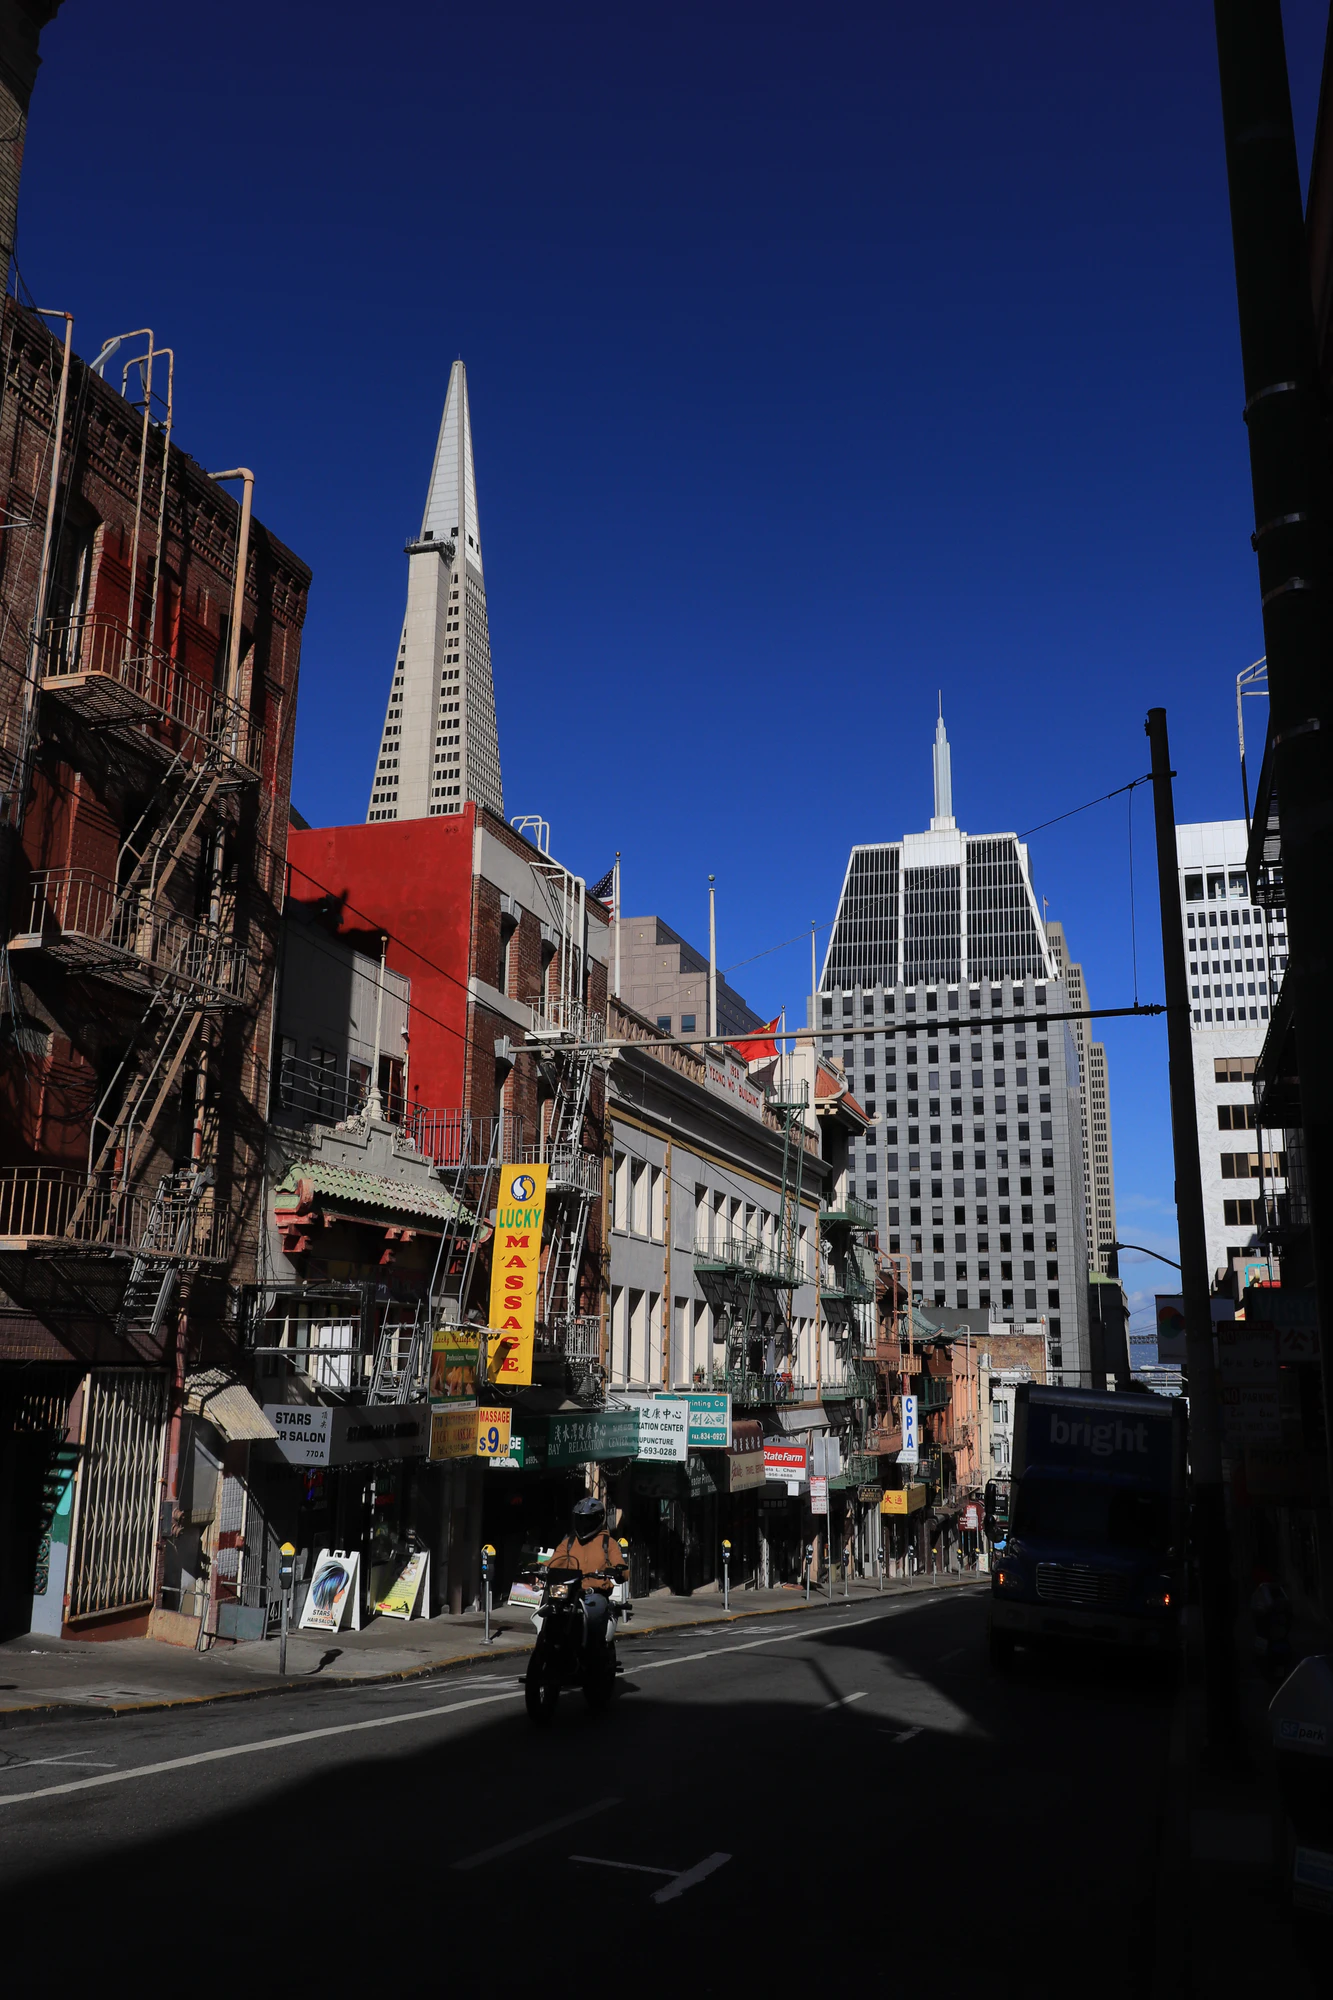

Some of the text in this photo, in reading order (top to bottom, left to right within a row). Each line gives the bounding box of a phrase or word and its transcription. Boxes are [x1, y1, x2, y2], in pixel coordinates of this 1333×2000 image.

[739, 1085, 759, 1108] BUILDING
[499, 1209, 541, 1228] LUCKY
[500, 1235, 529, 1372] MASSAGE
[1242, 1393, 1276, 1403] PARKING
[275, 1412, 312, 1426] STARS
[480, 1411, 510, 1423] MASSAGE
[905, 1397, 914, 1448] CPA
[660, 1424, 684, 1432] CENTER
[1050, 1413, 1148, 1456] bright
[289, 1431, 326, 1443] SALON
[500, 1444, 508, 1453] UP
[548, 1436, 629, 1456] BAY RELAXATION CENTER
